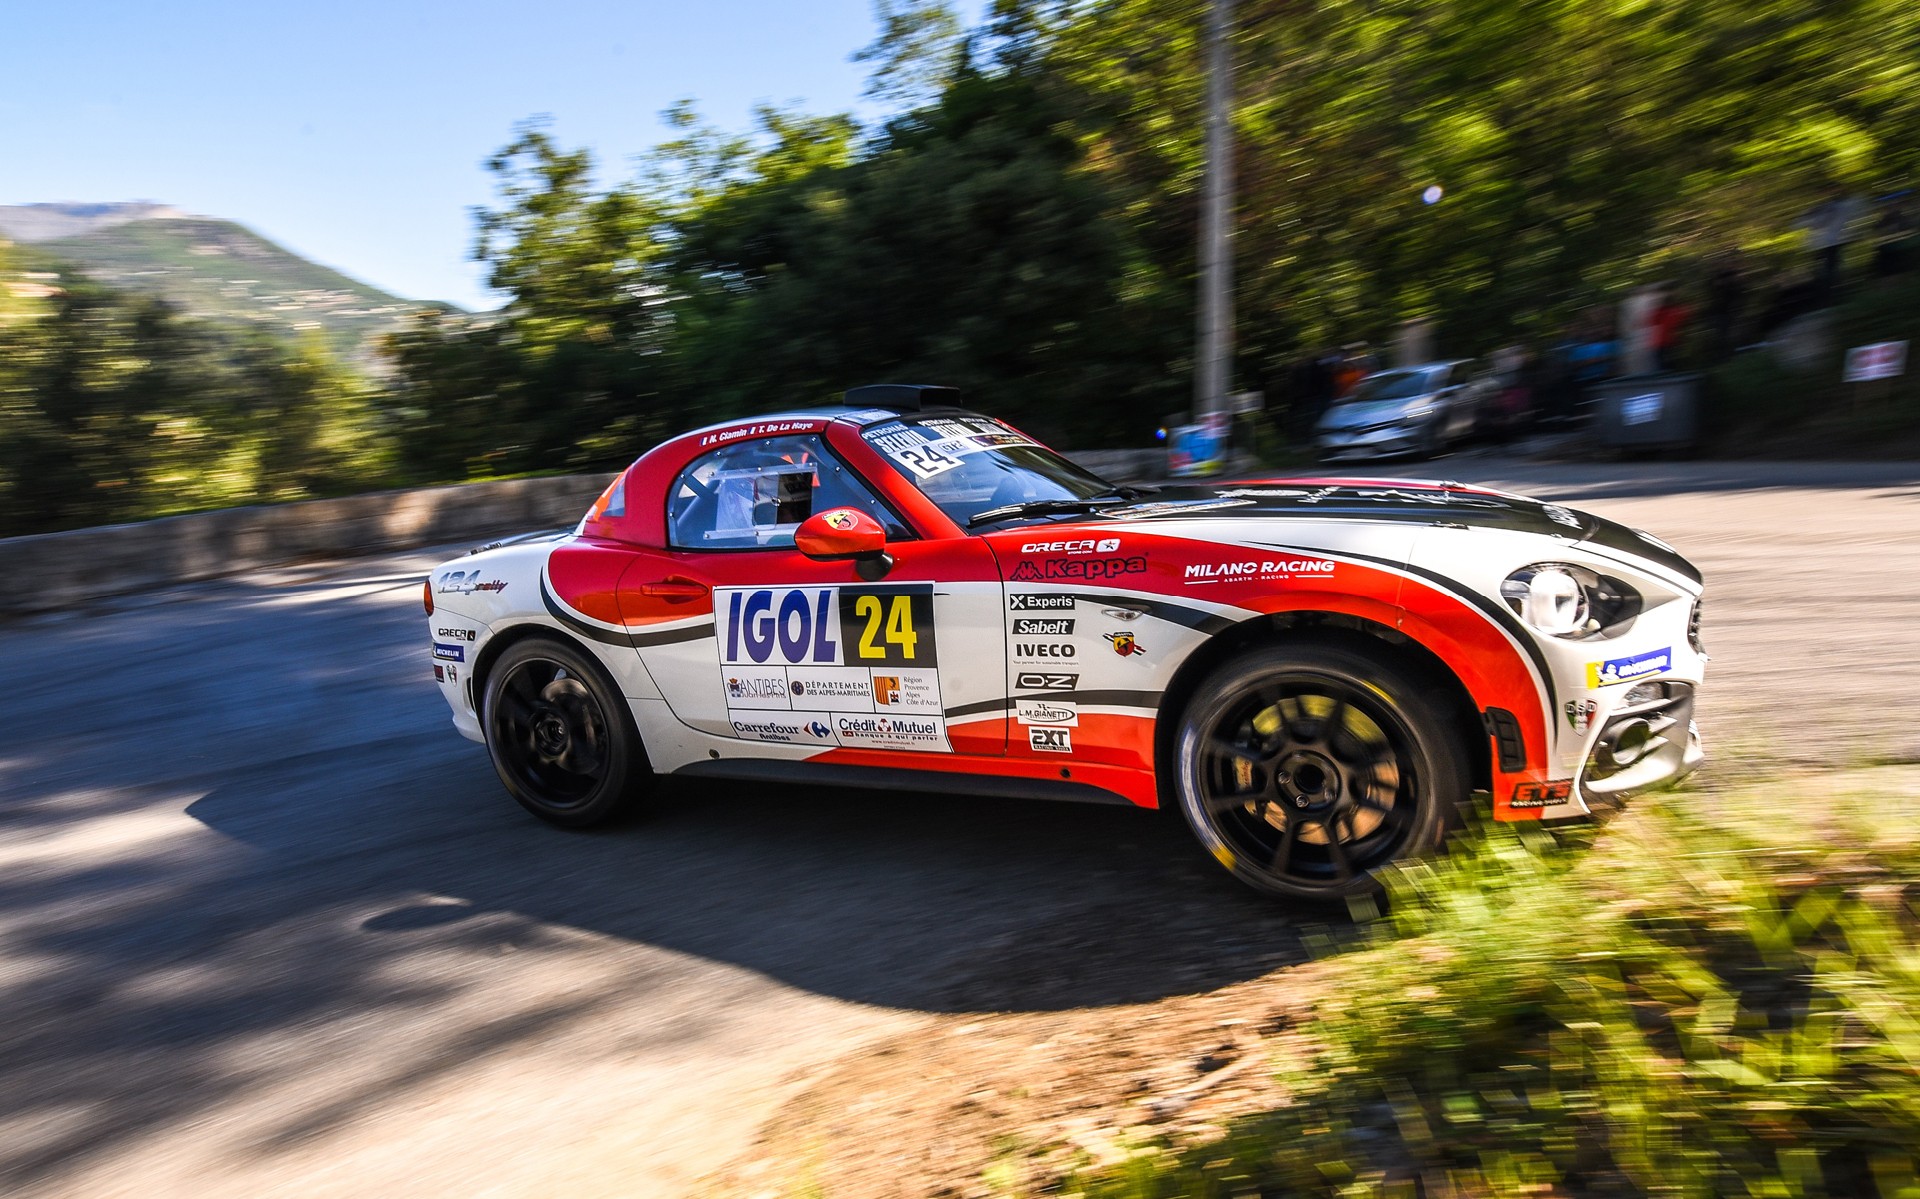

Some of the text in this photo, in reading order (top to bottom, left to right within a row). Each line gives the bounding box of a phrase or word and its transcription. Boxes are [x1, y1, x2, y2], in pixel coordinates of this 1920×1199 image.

[758, 422, 814, 433] T. De La Haye
[861, 423, 909, 440] PETRONAS
[719, 429, 747, 441] Ciamin
[872, 429, 931, 454] SELENIA
[900, 445, 955, 473] 24
[1021, 539, 1096, 553] ORECA
[1046, 556, 1147, 580] Kappa
[1184, 560, 1335, 578] MILANO RACING
[438, 569, 481, 595] 124
[1027, 595, 1073, 609] Experis
[438, 628, 467, 637] ORECA
[726, 589, 836, 663] IGOL
[855, 595, 918, 659] 24
[1018, 620, 1069, 634] Sabelt
[1016, 644, 1076, 657] IVECO
[741, 678, 786, 696] ANTIBES
[805, 680, 869, 690] DÉPARTEMENT
[903, 676, 923, 684] Région
[818, 689, 870, 697] ALPES-MARITIMES
[733, 721, 800, 735] Carrefour
[838, 718, 937, 734] Crédit Mutuel
[759, 733, 791, 741] Antibes
[1031, 729, 1068, 746] EXT
